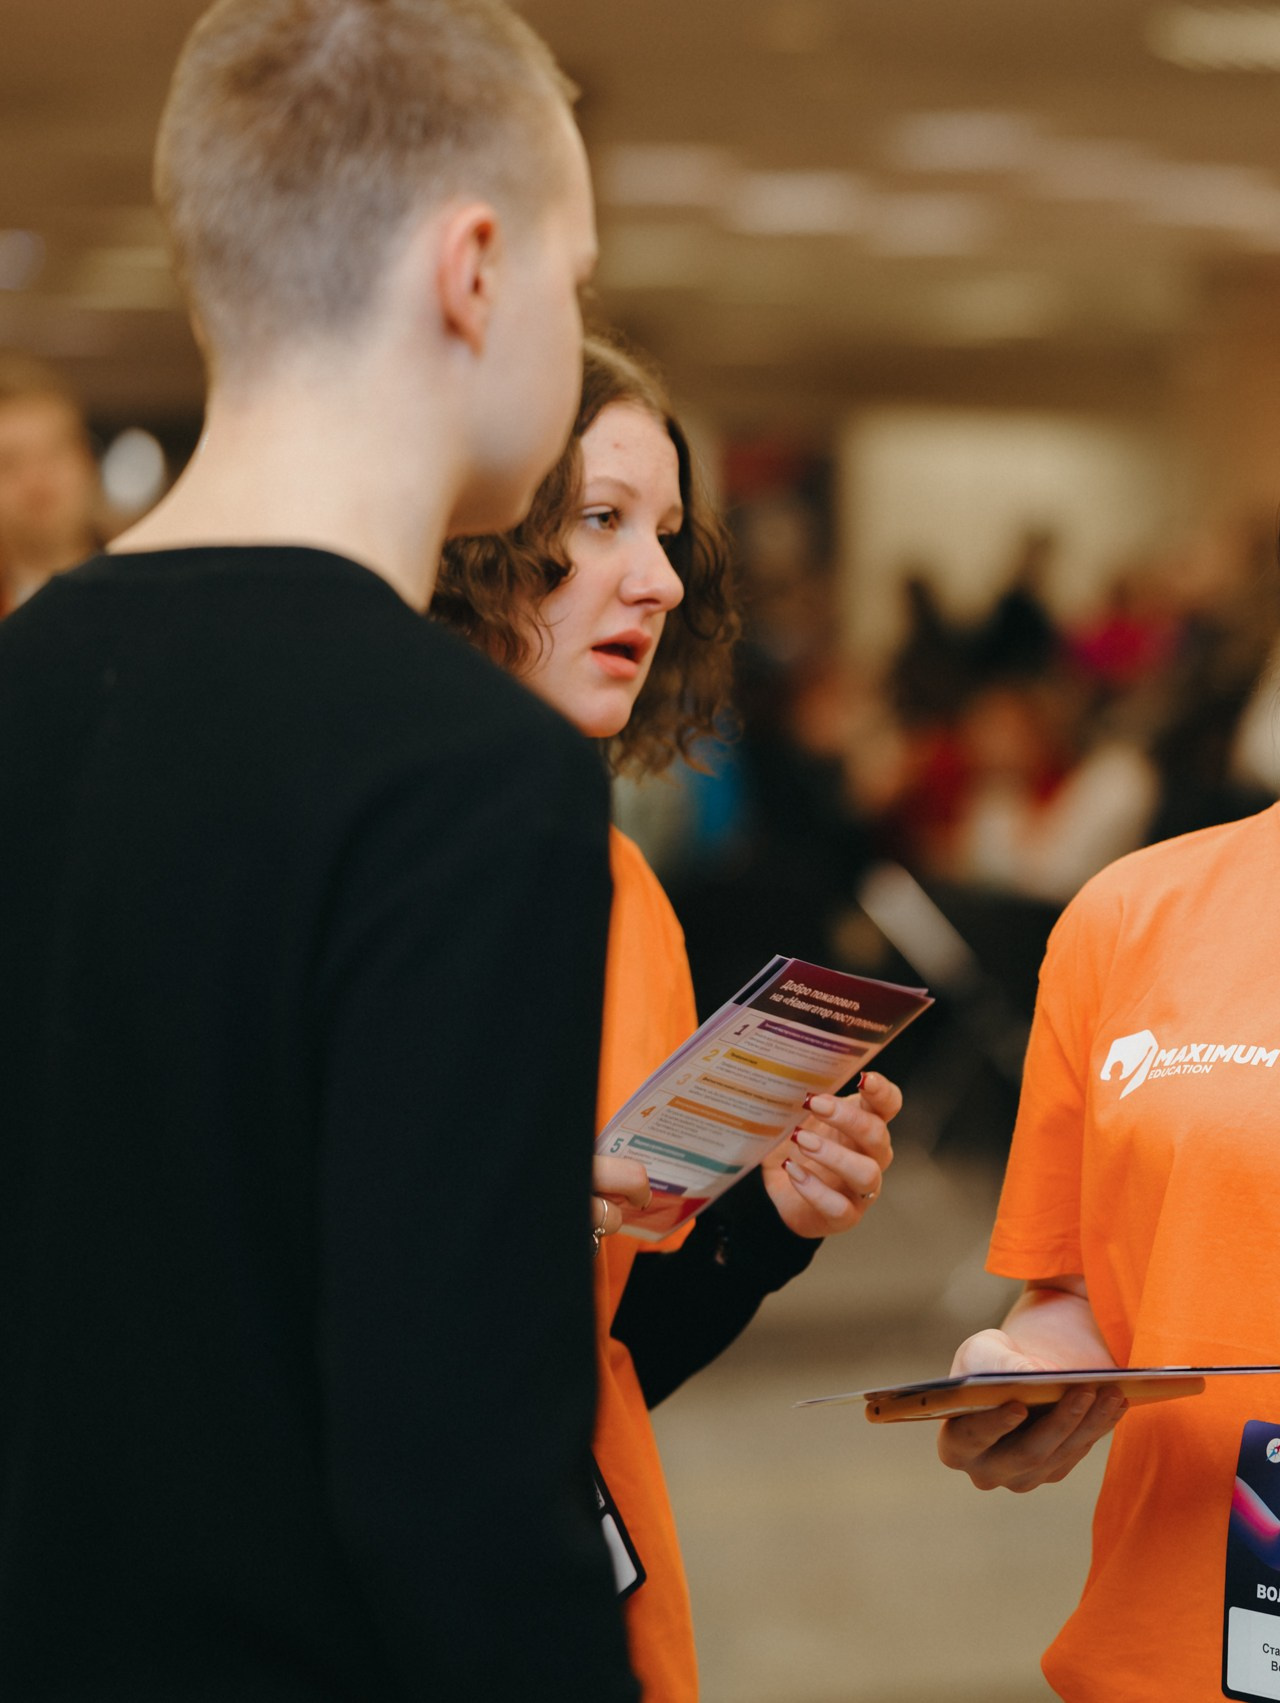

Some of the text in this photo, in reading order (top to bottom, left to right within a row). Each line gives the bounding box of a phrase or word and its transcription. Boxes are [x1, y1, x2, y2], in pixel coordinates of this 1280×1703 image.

[769, 992, 785, 1003] на
[780, 979, 860, 1012] Добро пожаловать
[733, 1023, 750, 1036] 1
[702, 1048, 721, 1062] 2
[1152, 1043, 1280, 1068] MAXIMUM
[1148, 1064, 1214, 1080] EDUCATION
[675, 1073, 693, 1086] 3
[640, 1106, 656, 1119] 4
[610, 1138, 625, 1153] 5
